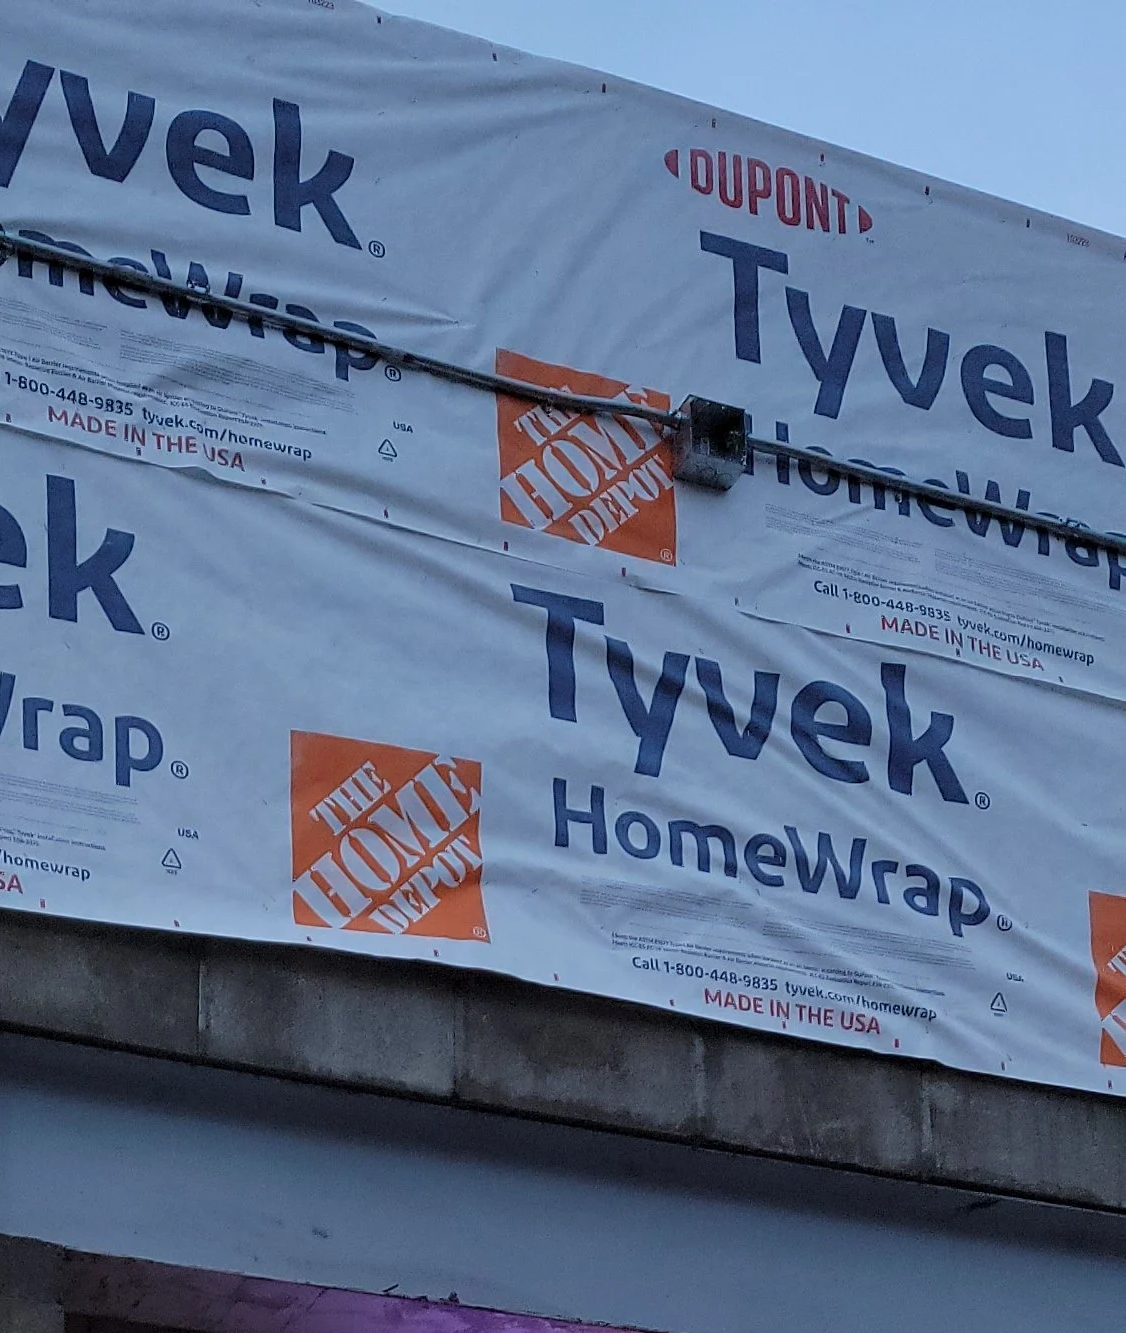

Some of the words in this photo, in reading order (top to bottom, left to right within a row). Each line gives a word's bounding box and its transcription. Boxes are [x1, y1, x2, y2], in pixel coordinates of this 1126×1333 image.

[689, 148, 851, 234] DUPONT
[700, 230, 1125, 468] Tyvek
[4, 372, 134, 416] 1-800-448-9835
[142, 407, 312, 462] tyvek.com/homewrap
[48, 406, 117, 438] MADE
[123, 426, 146, 447] IN
[152, 432, 198, 454] THE
[203, 443, 245, 472] USA
[393, 421, 414, 434] USA
[814, 580, 839, 598] Call
[842, 588, 951, 622] 1-800-448-9835
[957, 614, 1095, 666] tyvek.com/homewrap
[881, 615, 939, 641] MADE
[945, 628, 963, 649] IN
[967, 636, 1001, 661] THE
[1007, 649, 1044, 671] USA
[509, 583, 970, 804] Tyvek
[177, 827, 200, 841] USA
[309, 761, 391, 836] THE
[292, 755, 483, 929] HOME
[368, 834, 483, 934] DEPOT
[553, 777, 991, 937] HomeWrap
[632, 956, 660, 973] Call
[663, 961, 778, 991] 1-800-448-9835
[785, 980, 938, 1022] tyvek.com/homewrap
[704, 987, 763, 1015] MADE
[770, 1003, 789, 1021] IN
[796, 1005, 834, 1028] THE
[840, 1012, 880, 1035] USA
